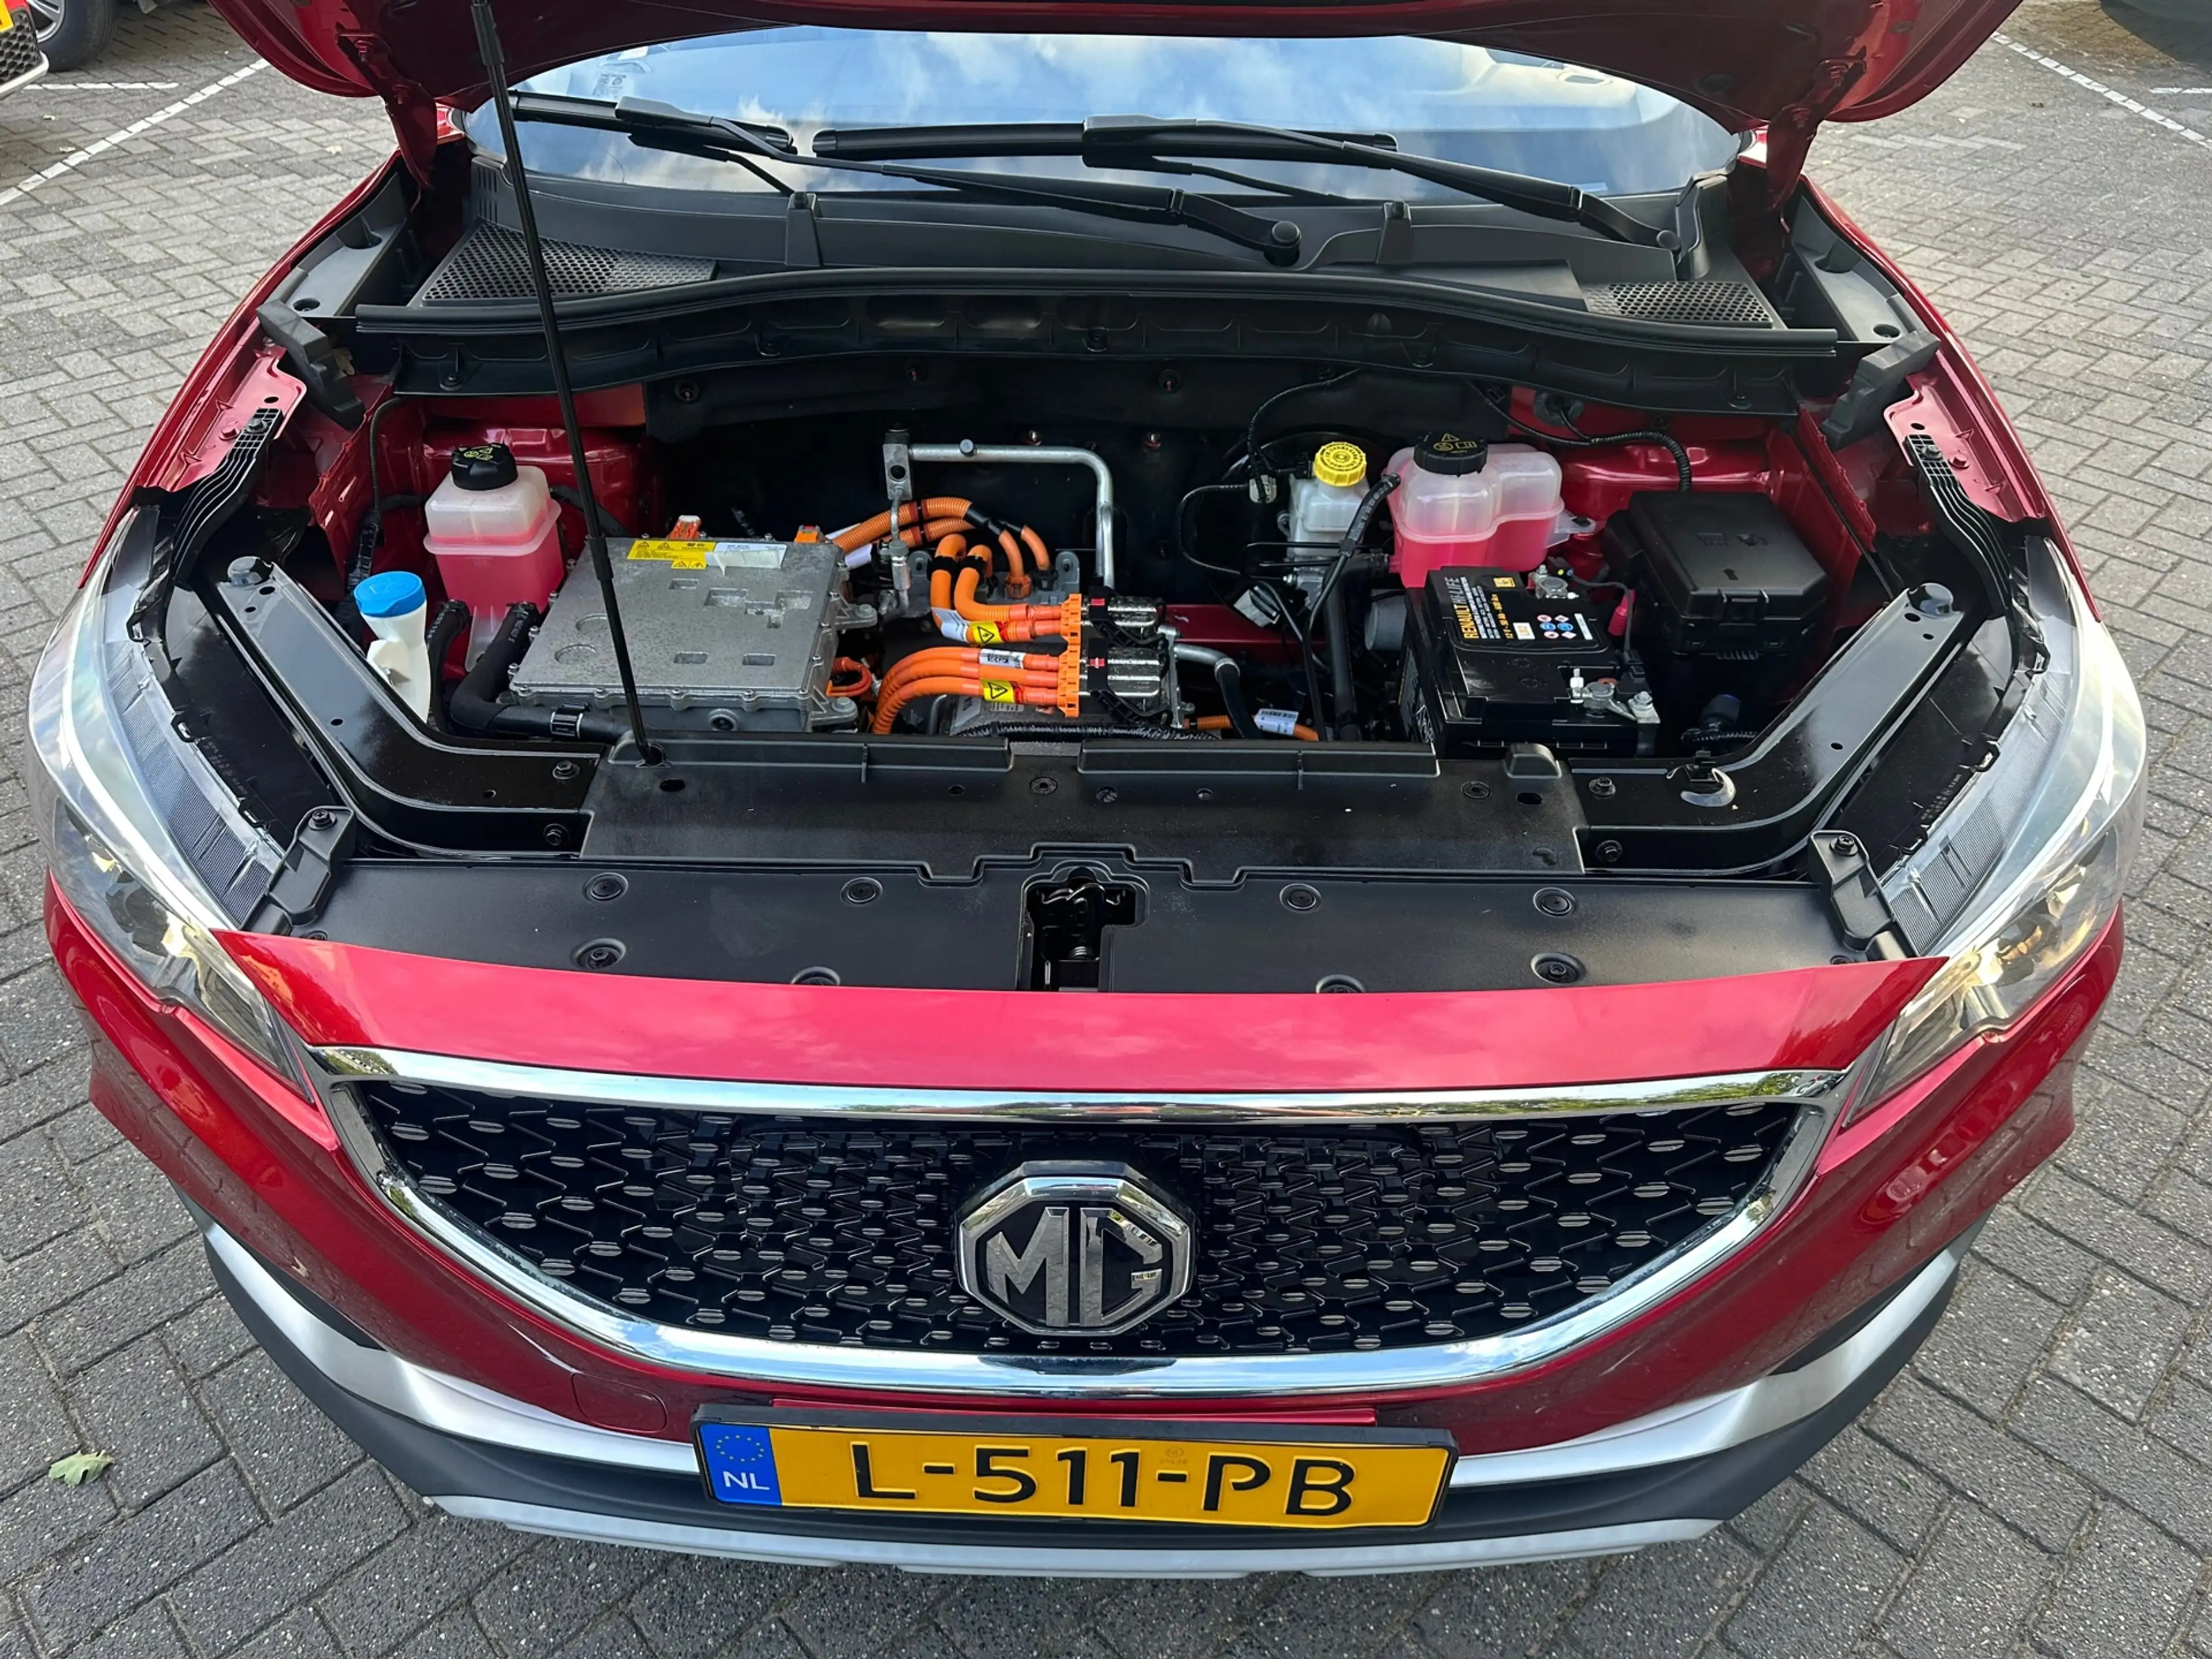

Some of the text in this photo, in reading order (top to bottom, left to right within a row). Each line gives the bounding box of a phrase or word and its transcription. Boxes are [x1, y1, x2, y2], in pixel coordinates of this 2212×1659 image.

[1453, 604, 1480, 639] RENAULT
[986, 1207, 1163, 1327] MG
[722, 1470, 770, 1491] NL
[850, 1441, 1355, 1516] L-511-PB
